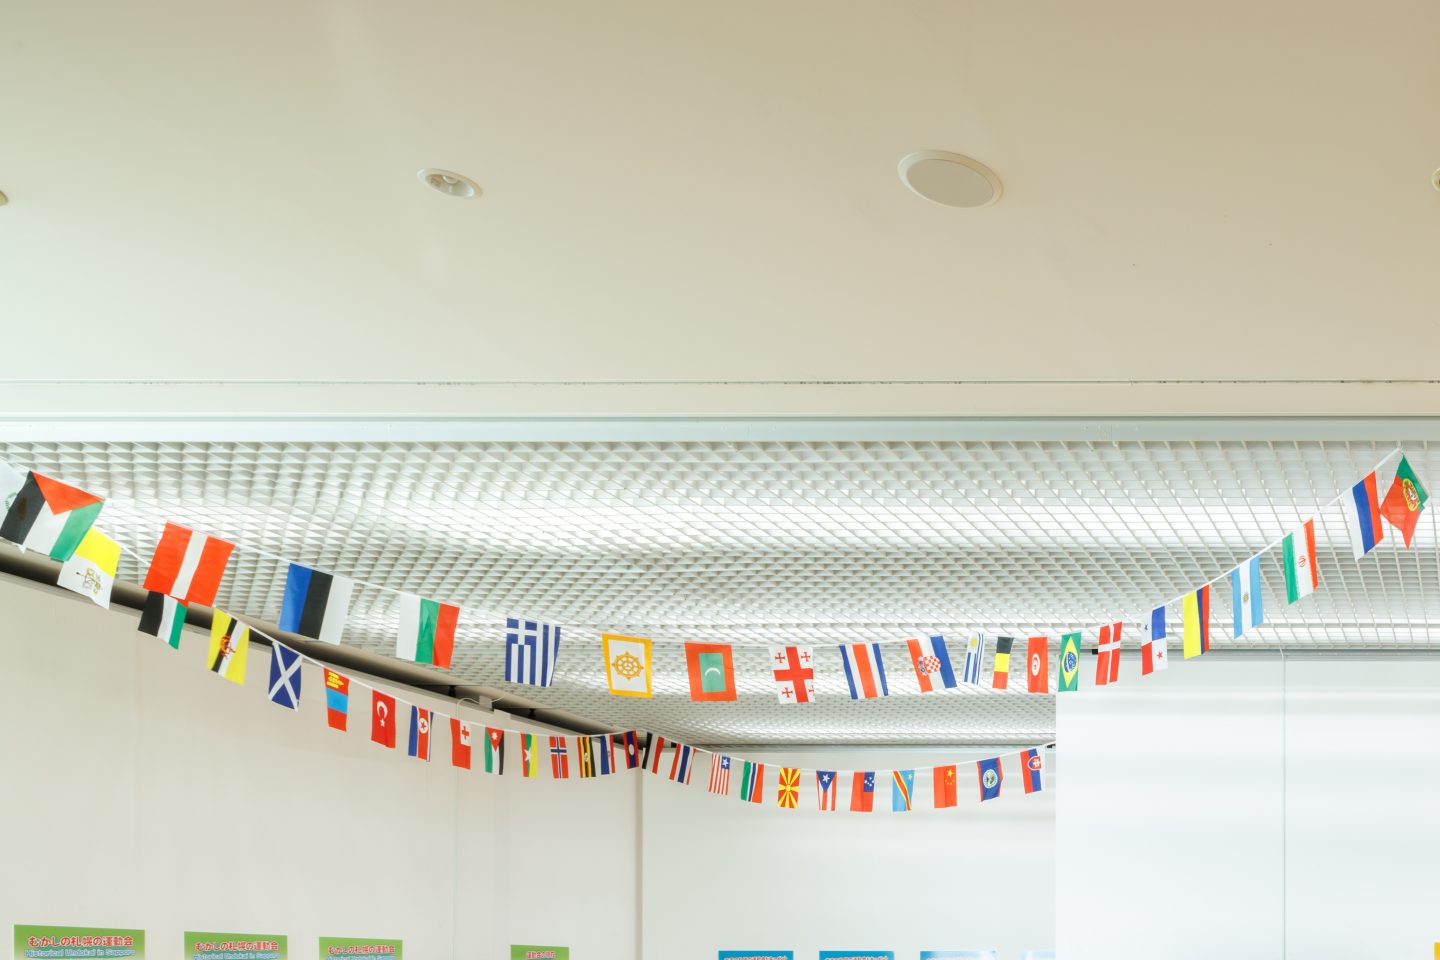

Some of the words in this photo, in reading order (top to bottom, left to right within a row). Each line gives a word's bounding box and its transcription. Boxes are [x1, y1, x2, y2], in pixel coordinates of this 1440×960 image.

[28, 936, 134, 947] むかしの札幌の運動会
